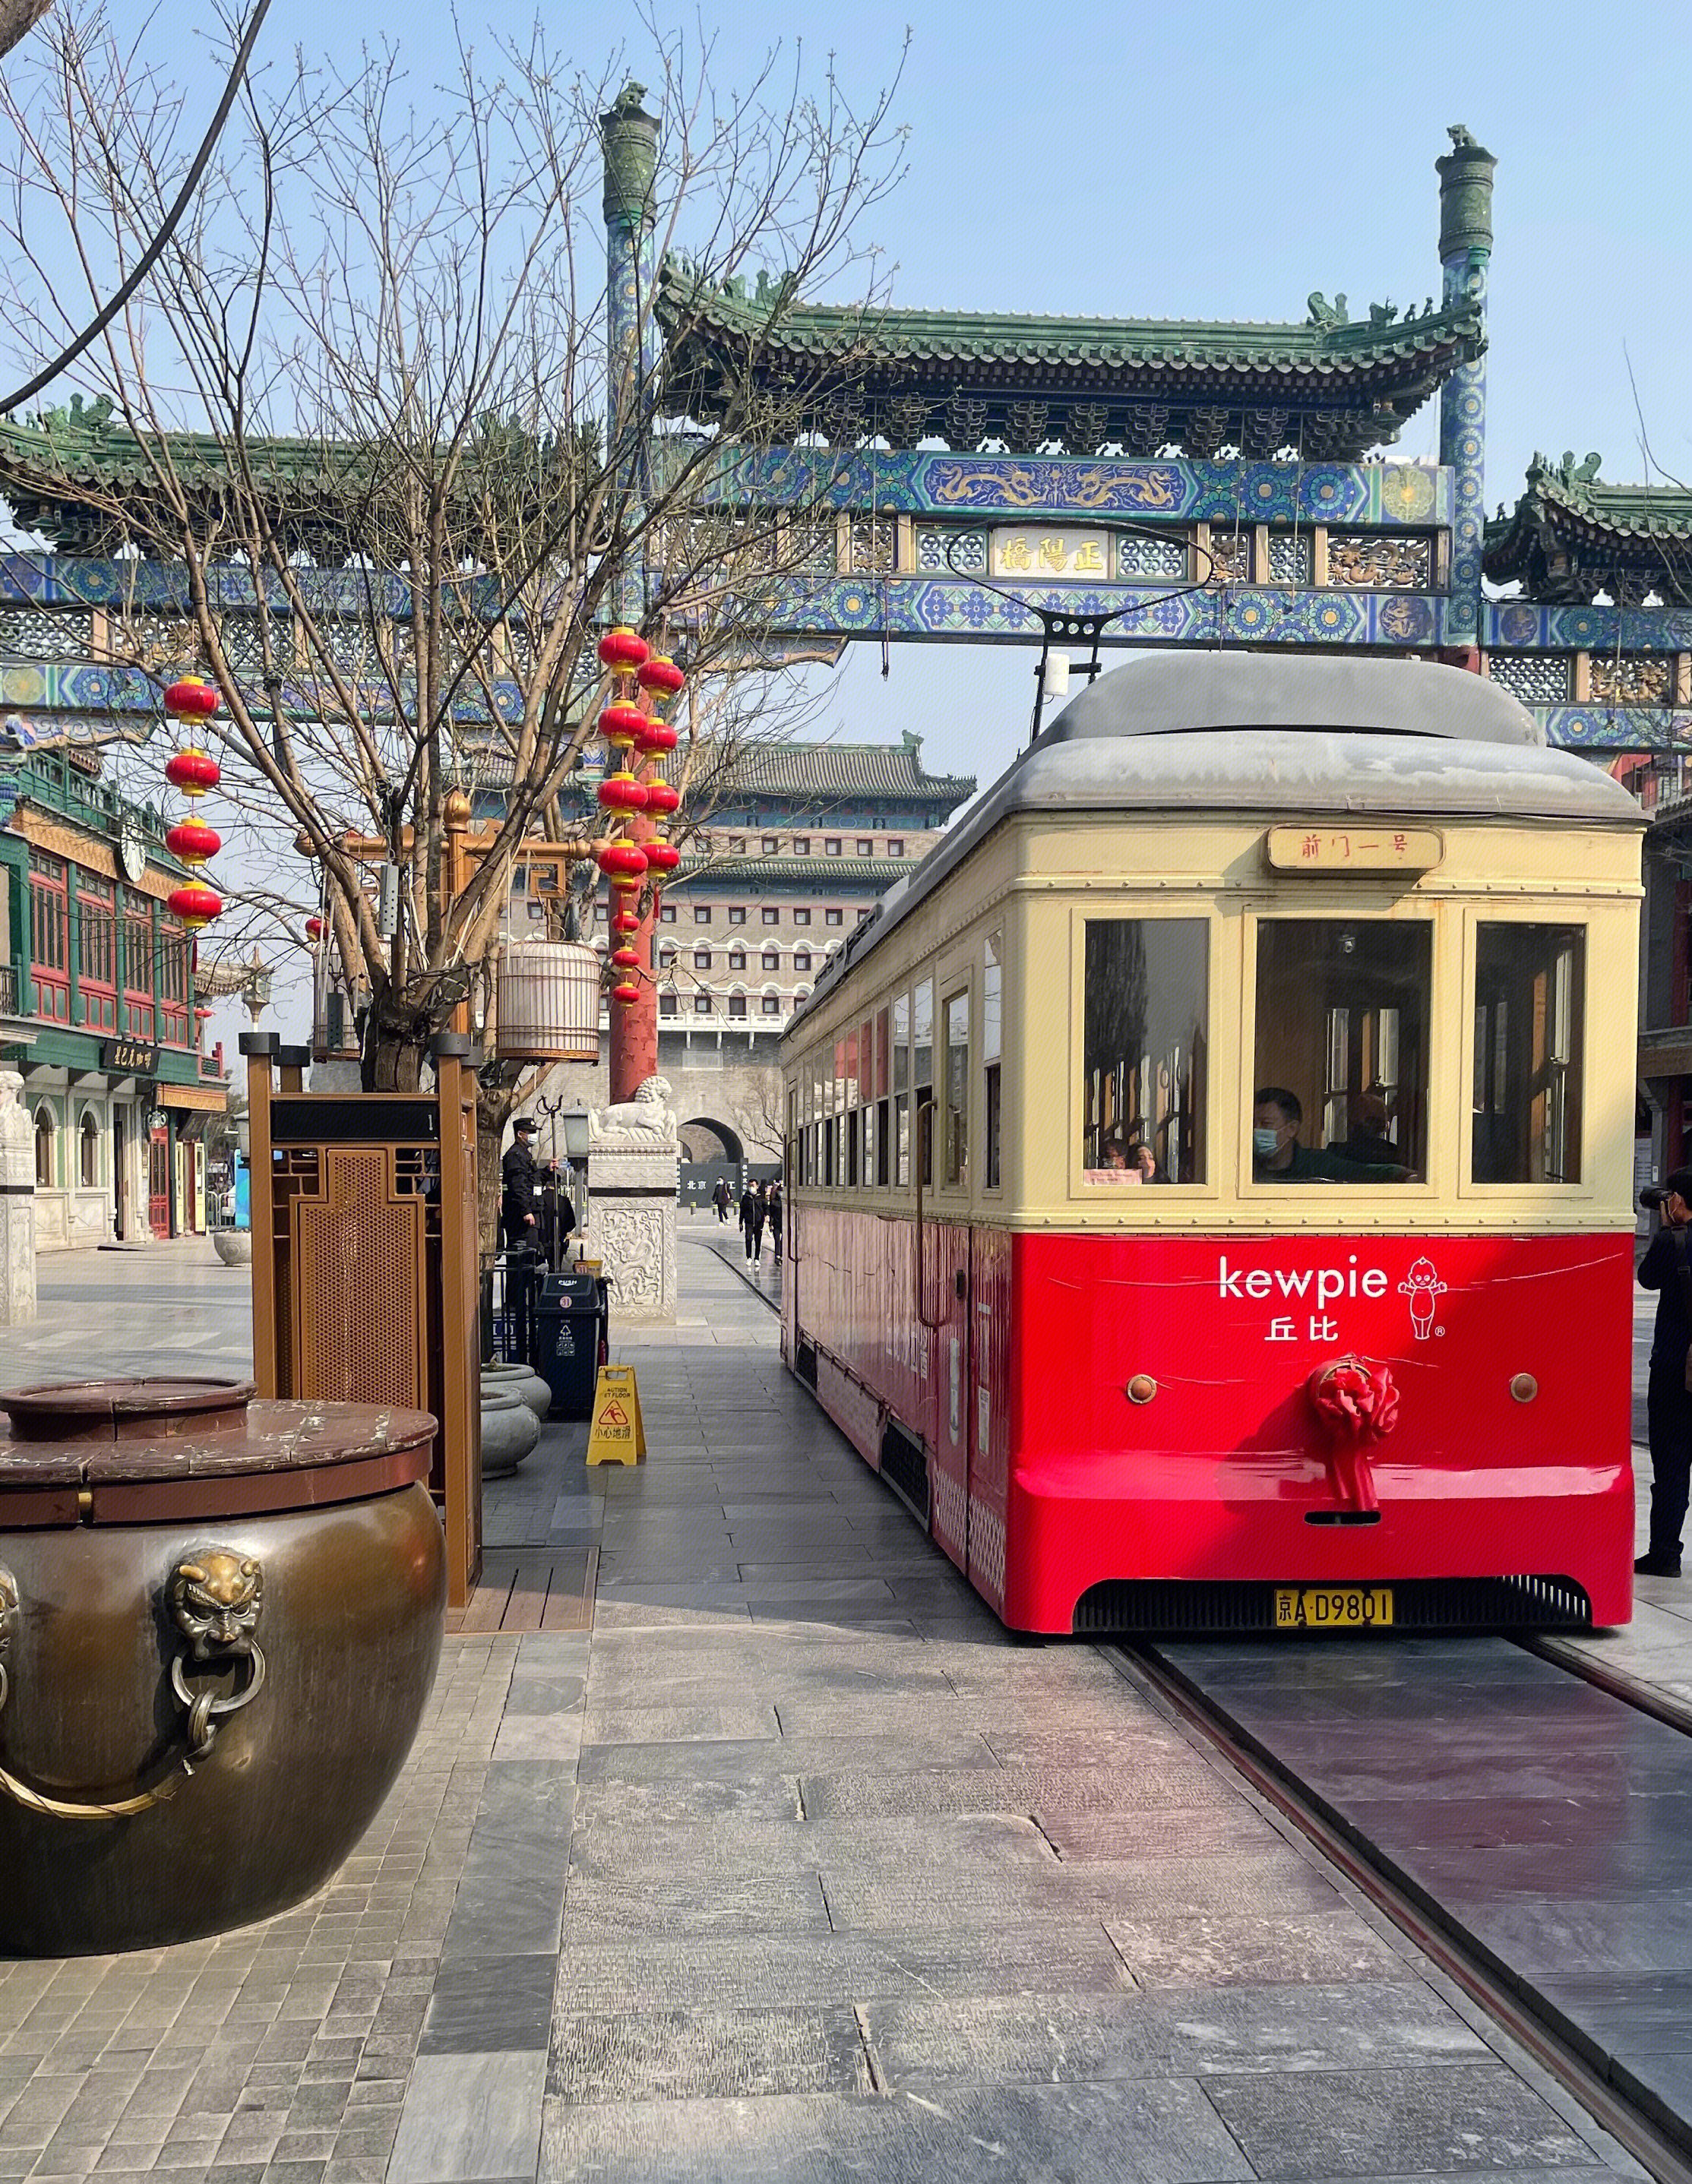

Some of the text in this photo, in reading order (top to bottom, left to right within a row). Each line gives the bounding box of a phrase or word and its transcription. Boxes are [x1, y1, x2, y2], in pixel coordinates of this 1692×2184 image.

[1301, 833, 1408, 860] 前门一号
[1219, 1254, 1388, 1310] kewpie
[1263, 1315, 1339, 1342] 丘比
[595, 1425, 631, 1440] 小心地滑
